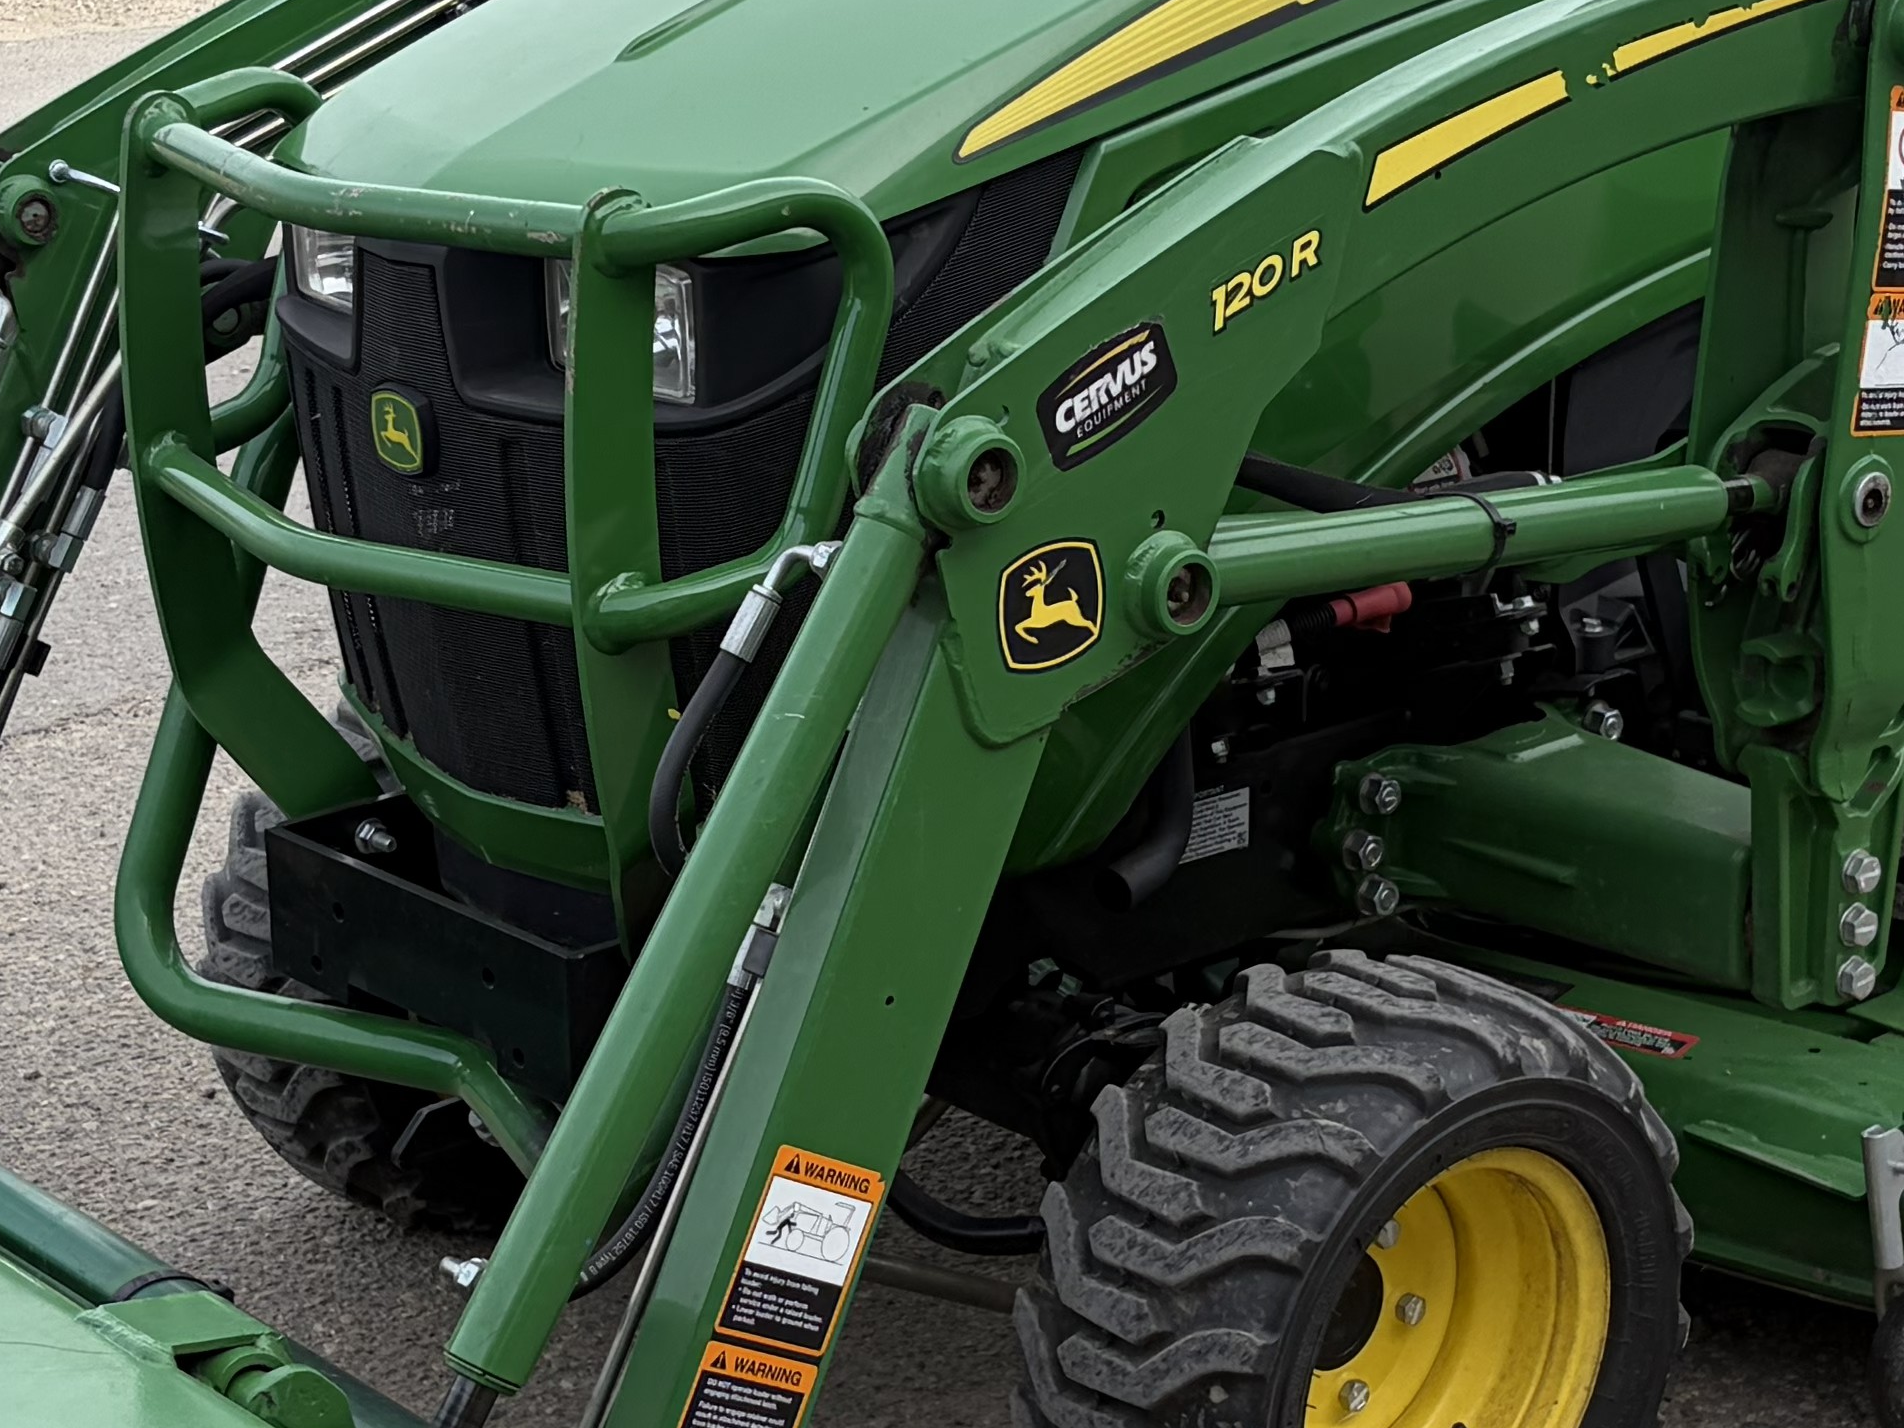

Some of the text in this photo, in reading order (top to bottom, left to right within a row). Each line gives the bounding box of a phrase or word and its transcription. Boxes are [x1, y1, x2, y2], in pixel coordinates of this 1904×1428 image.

[1055, 340, 1158, 434] CERVUS
[1076, 379, 1147, 438] EQUIPMENT
[804, 1160, 872, 1195] WARNING
[733, 1356, 803, 1387] WARNING
